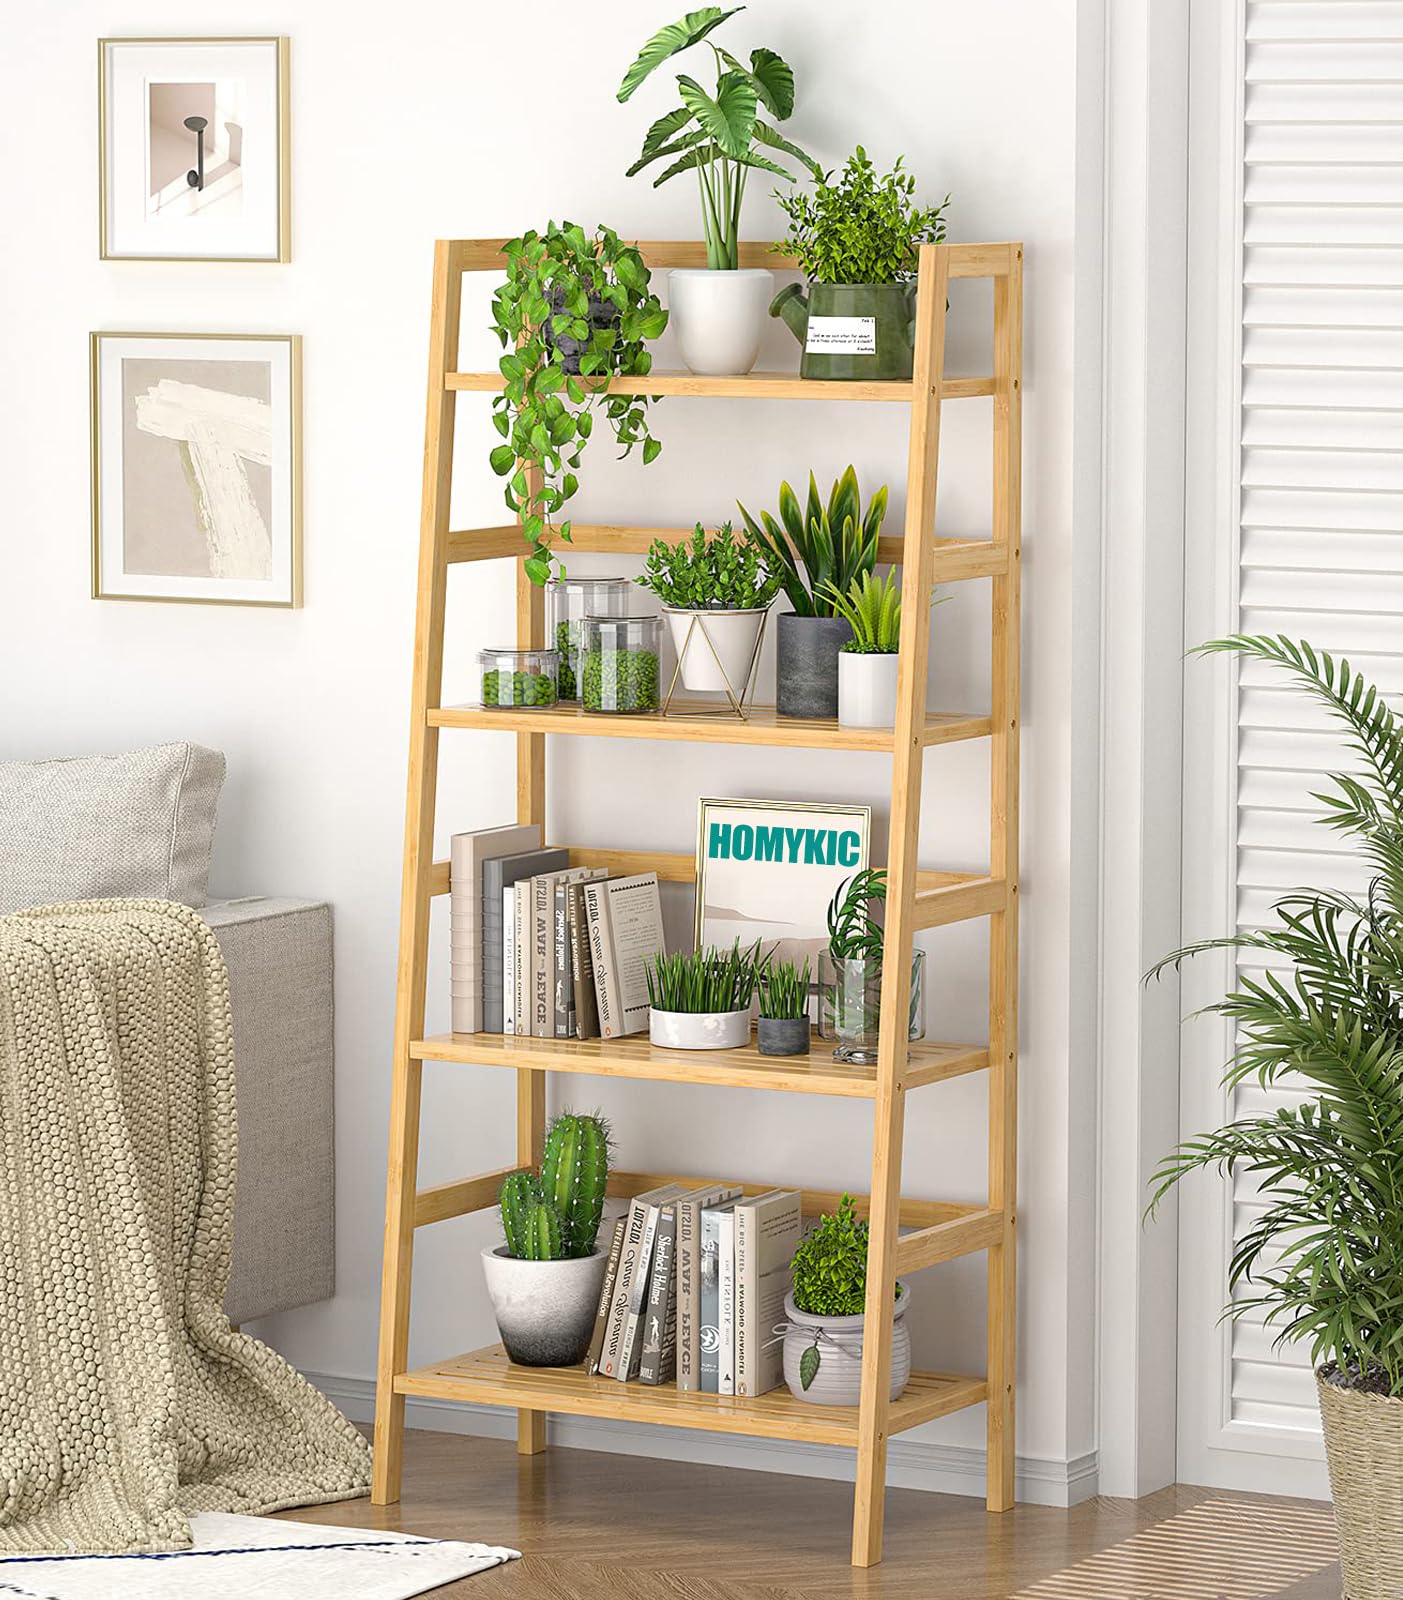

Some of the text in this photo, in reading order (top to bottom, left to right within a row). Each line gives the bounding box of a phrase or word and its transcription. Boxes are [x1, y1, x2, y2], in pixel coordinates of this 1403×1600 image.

[708, 823, 861, 867] HOMYKIC
[612, 1222, 624, 1262] REVEALING
[655, 1234, 672, 1272] Sherlock
[599, 1273, 616, 1317] Revolution
[650, 1274, 666, 1306] Holmes
